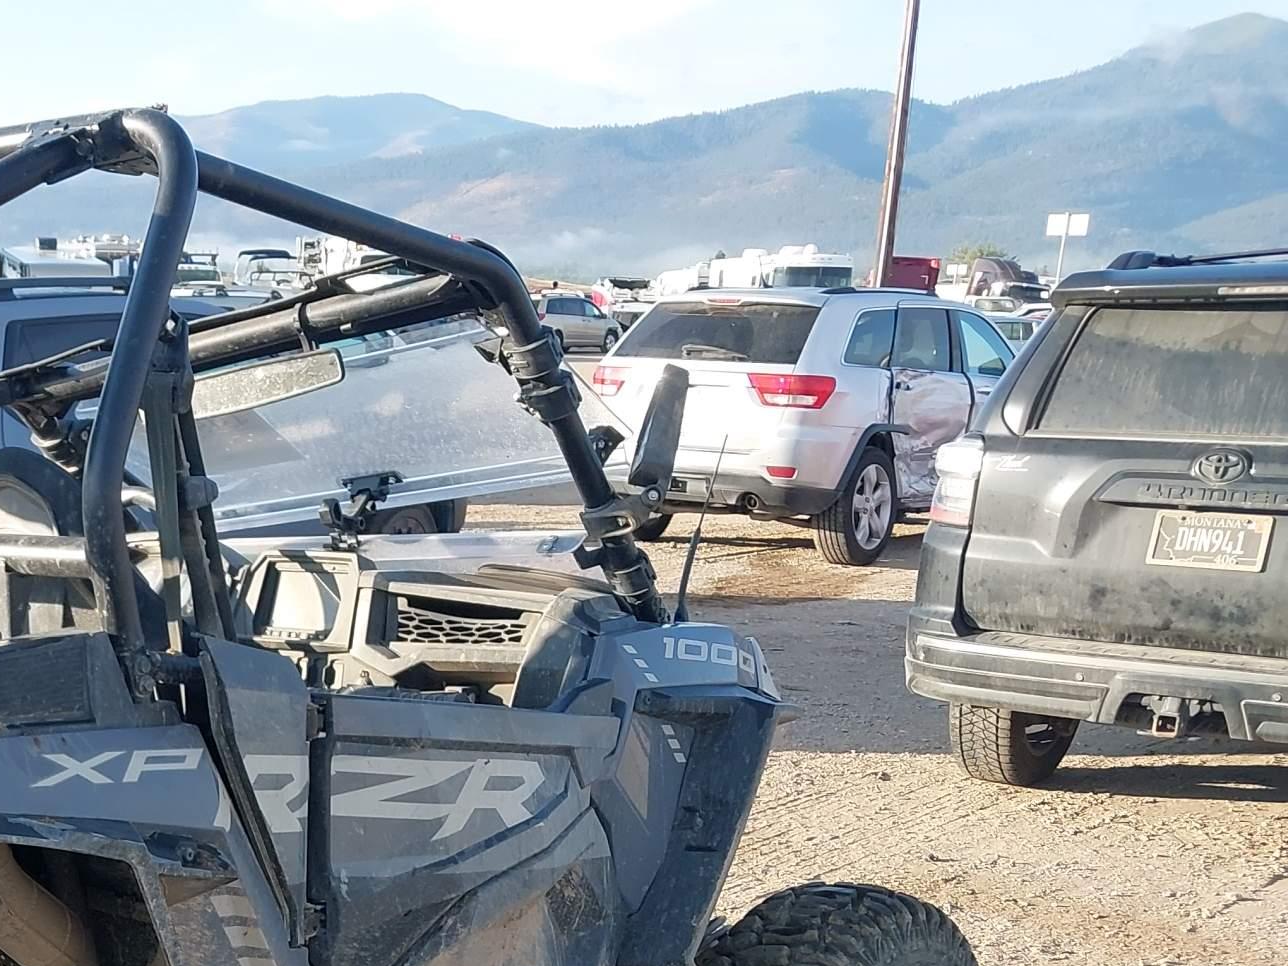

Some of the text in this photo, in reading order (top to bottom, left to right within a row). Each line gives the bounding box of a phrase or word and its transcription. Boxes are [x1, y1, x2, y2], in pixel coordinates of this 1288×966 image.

[1184, 515, 1242, 529] MONTANA
[1174, 527, 1245, 555] DHN941
[1213, 553, 1238, 566] 406
[663, 637, 755, 674] 1000
[31, 748, 203, 788] XP
[214, 753, 546, 841] RZR
